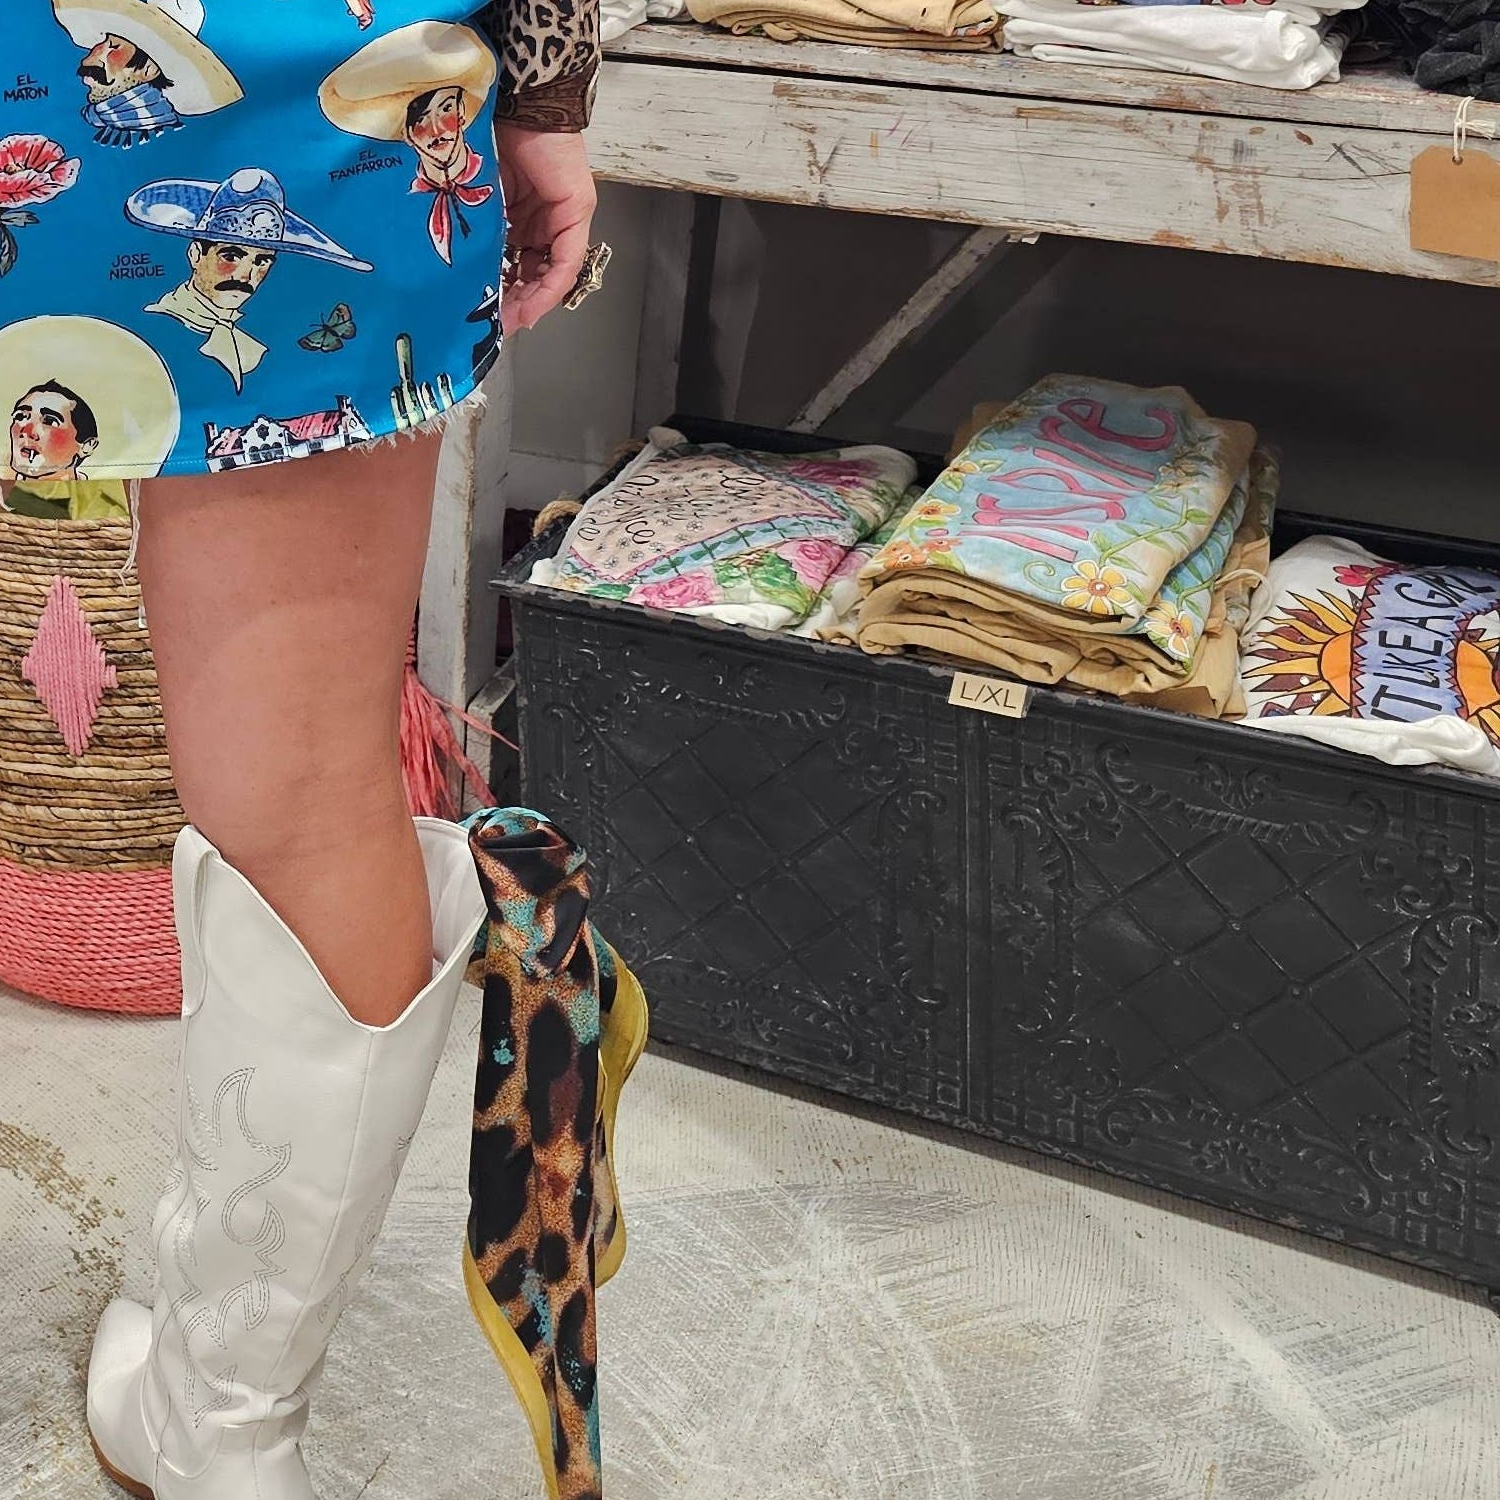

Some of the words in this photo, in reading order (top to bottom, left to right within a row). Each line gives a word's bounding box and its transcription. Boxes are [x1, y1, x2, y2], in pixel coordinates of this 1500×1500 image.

[16, 73, 38, 87] EL
[3, 85, 49, 103] MATON
[358, 148, 378, 162] EL
[328, 155, 404, 182] FANFARRON
[111, 252, 152, 268] JOSE
[108, 264, 165, 280] NRIQUE
[1384, 614, 1456, 638] A
[960, 681, 1017, 710] L/XL
